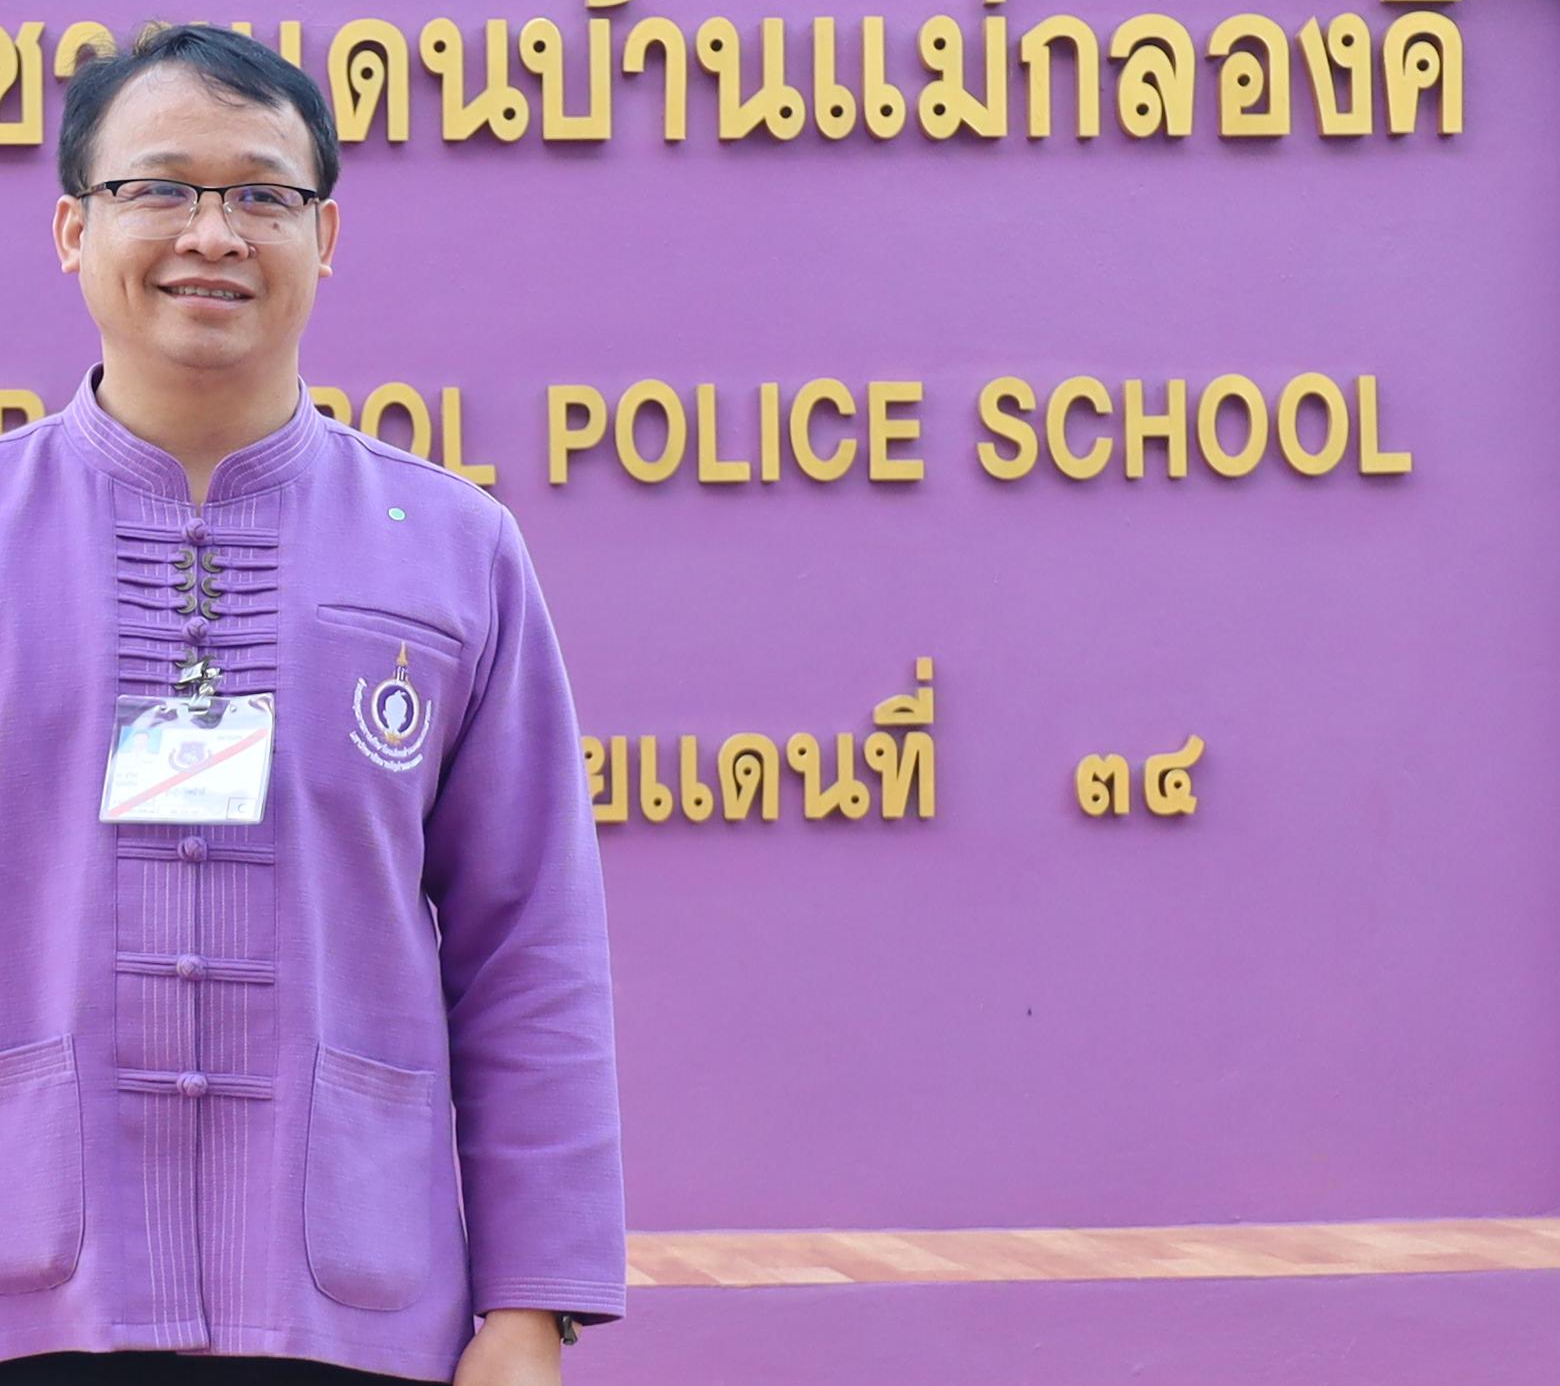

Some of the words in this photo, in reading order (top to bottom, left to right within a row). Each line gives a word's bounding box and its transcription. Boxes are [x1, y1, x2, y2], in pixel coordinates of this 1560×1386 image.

[547, 377, 926, 484] POLICE
[977, 371, 1414, 481] SCHOOL
[1074, 734, 1206, 817] ๓๔
